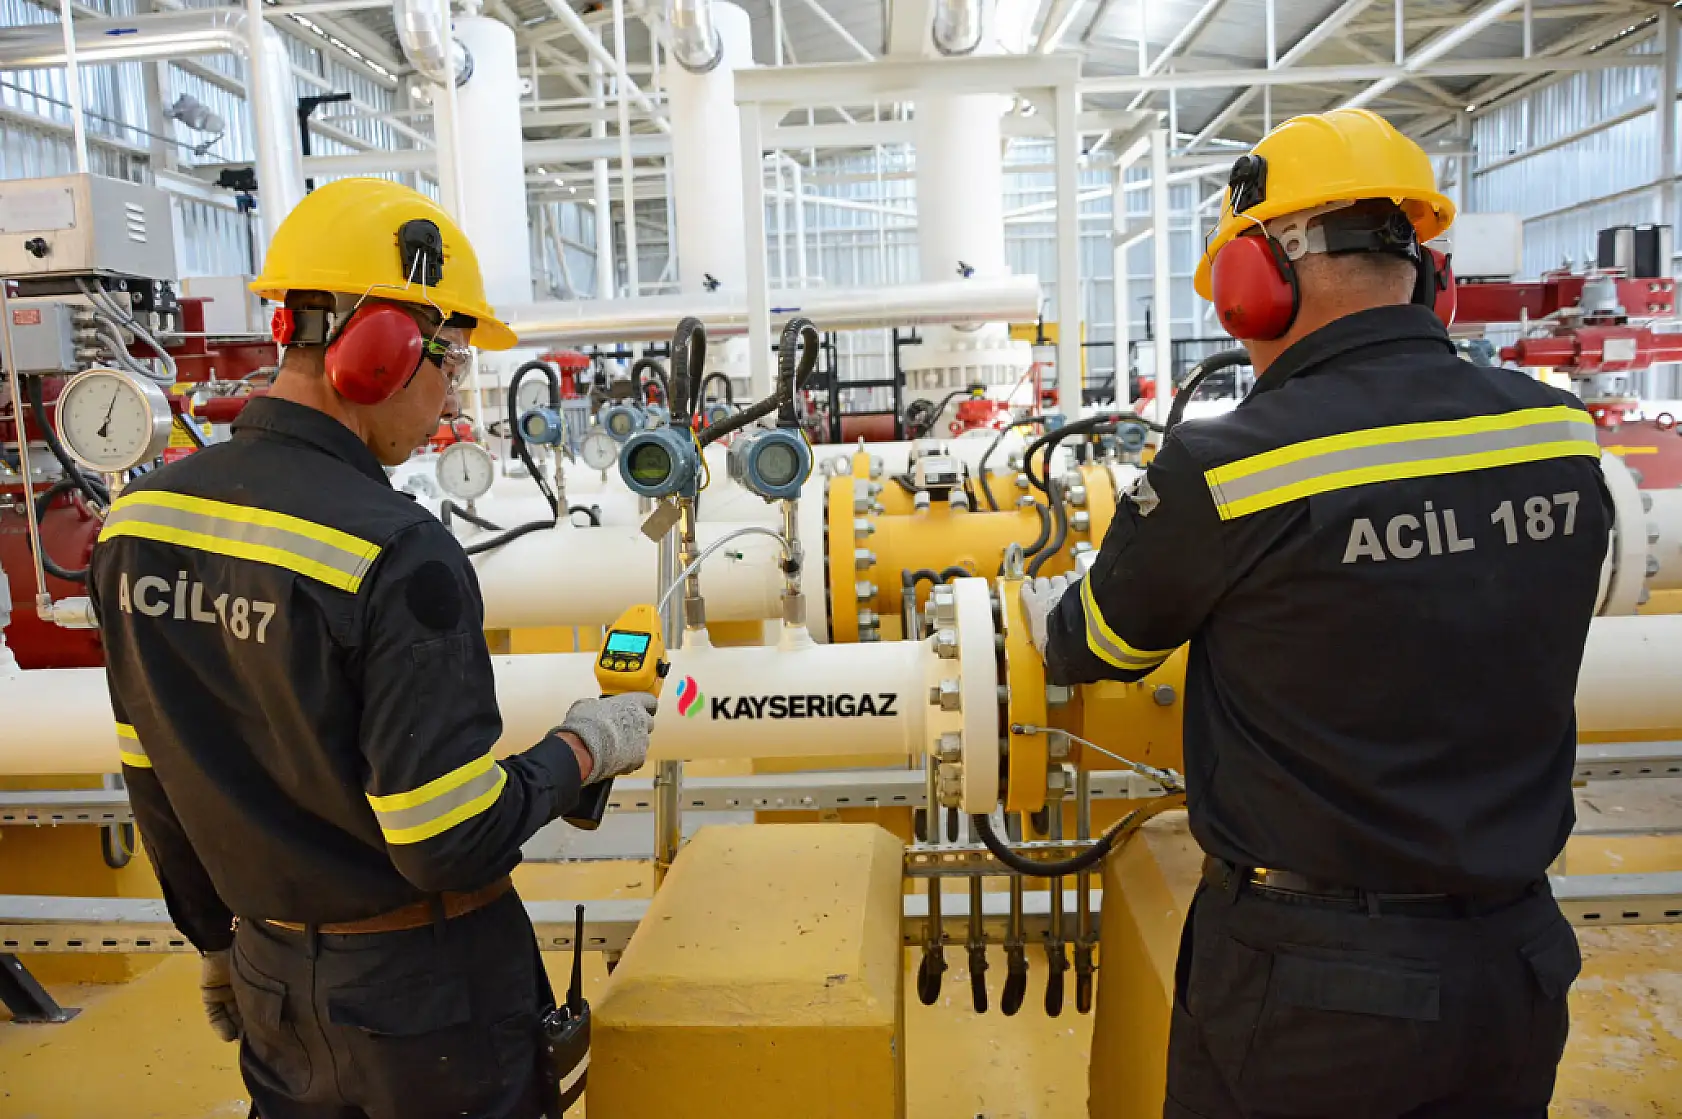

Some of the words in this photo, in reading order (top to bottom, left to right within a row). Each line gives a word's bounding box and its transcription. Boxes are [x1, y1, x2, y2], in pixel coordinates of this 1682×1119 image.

[1342, 500, 1476, 564] ACİL
[1490, 490, 1580, 544] 187
[118, 570, 217, 624] ACİL
[213, 593, 276, 644] 187
